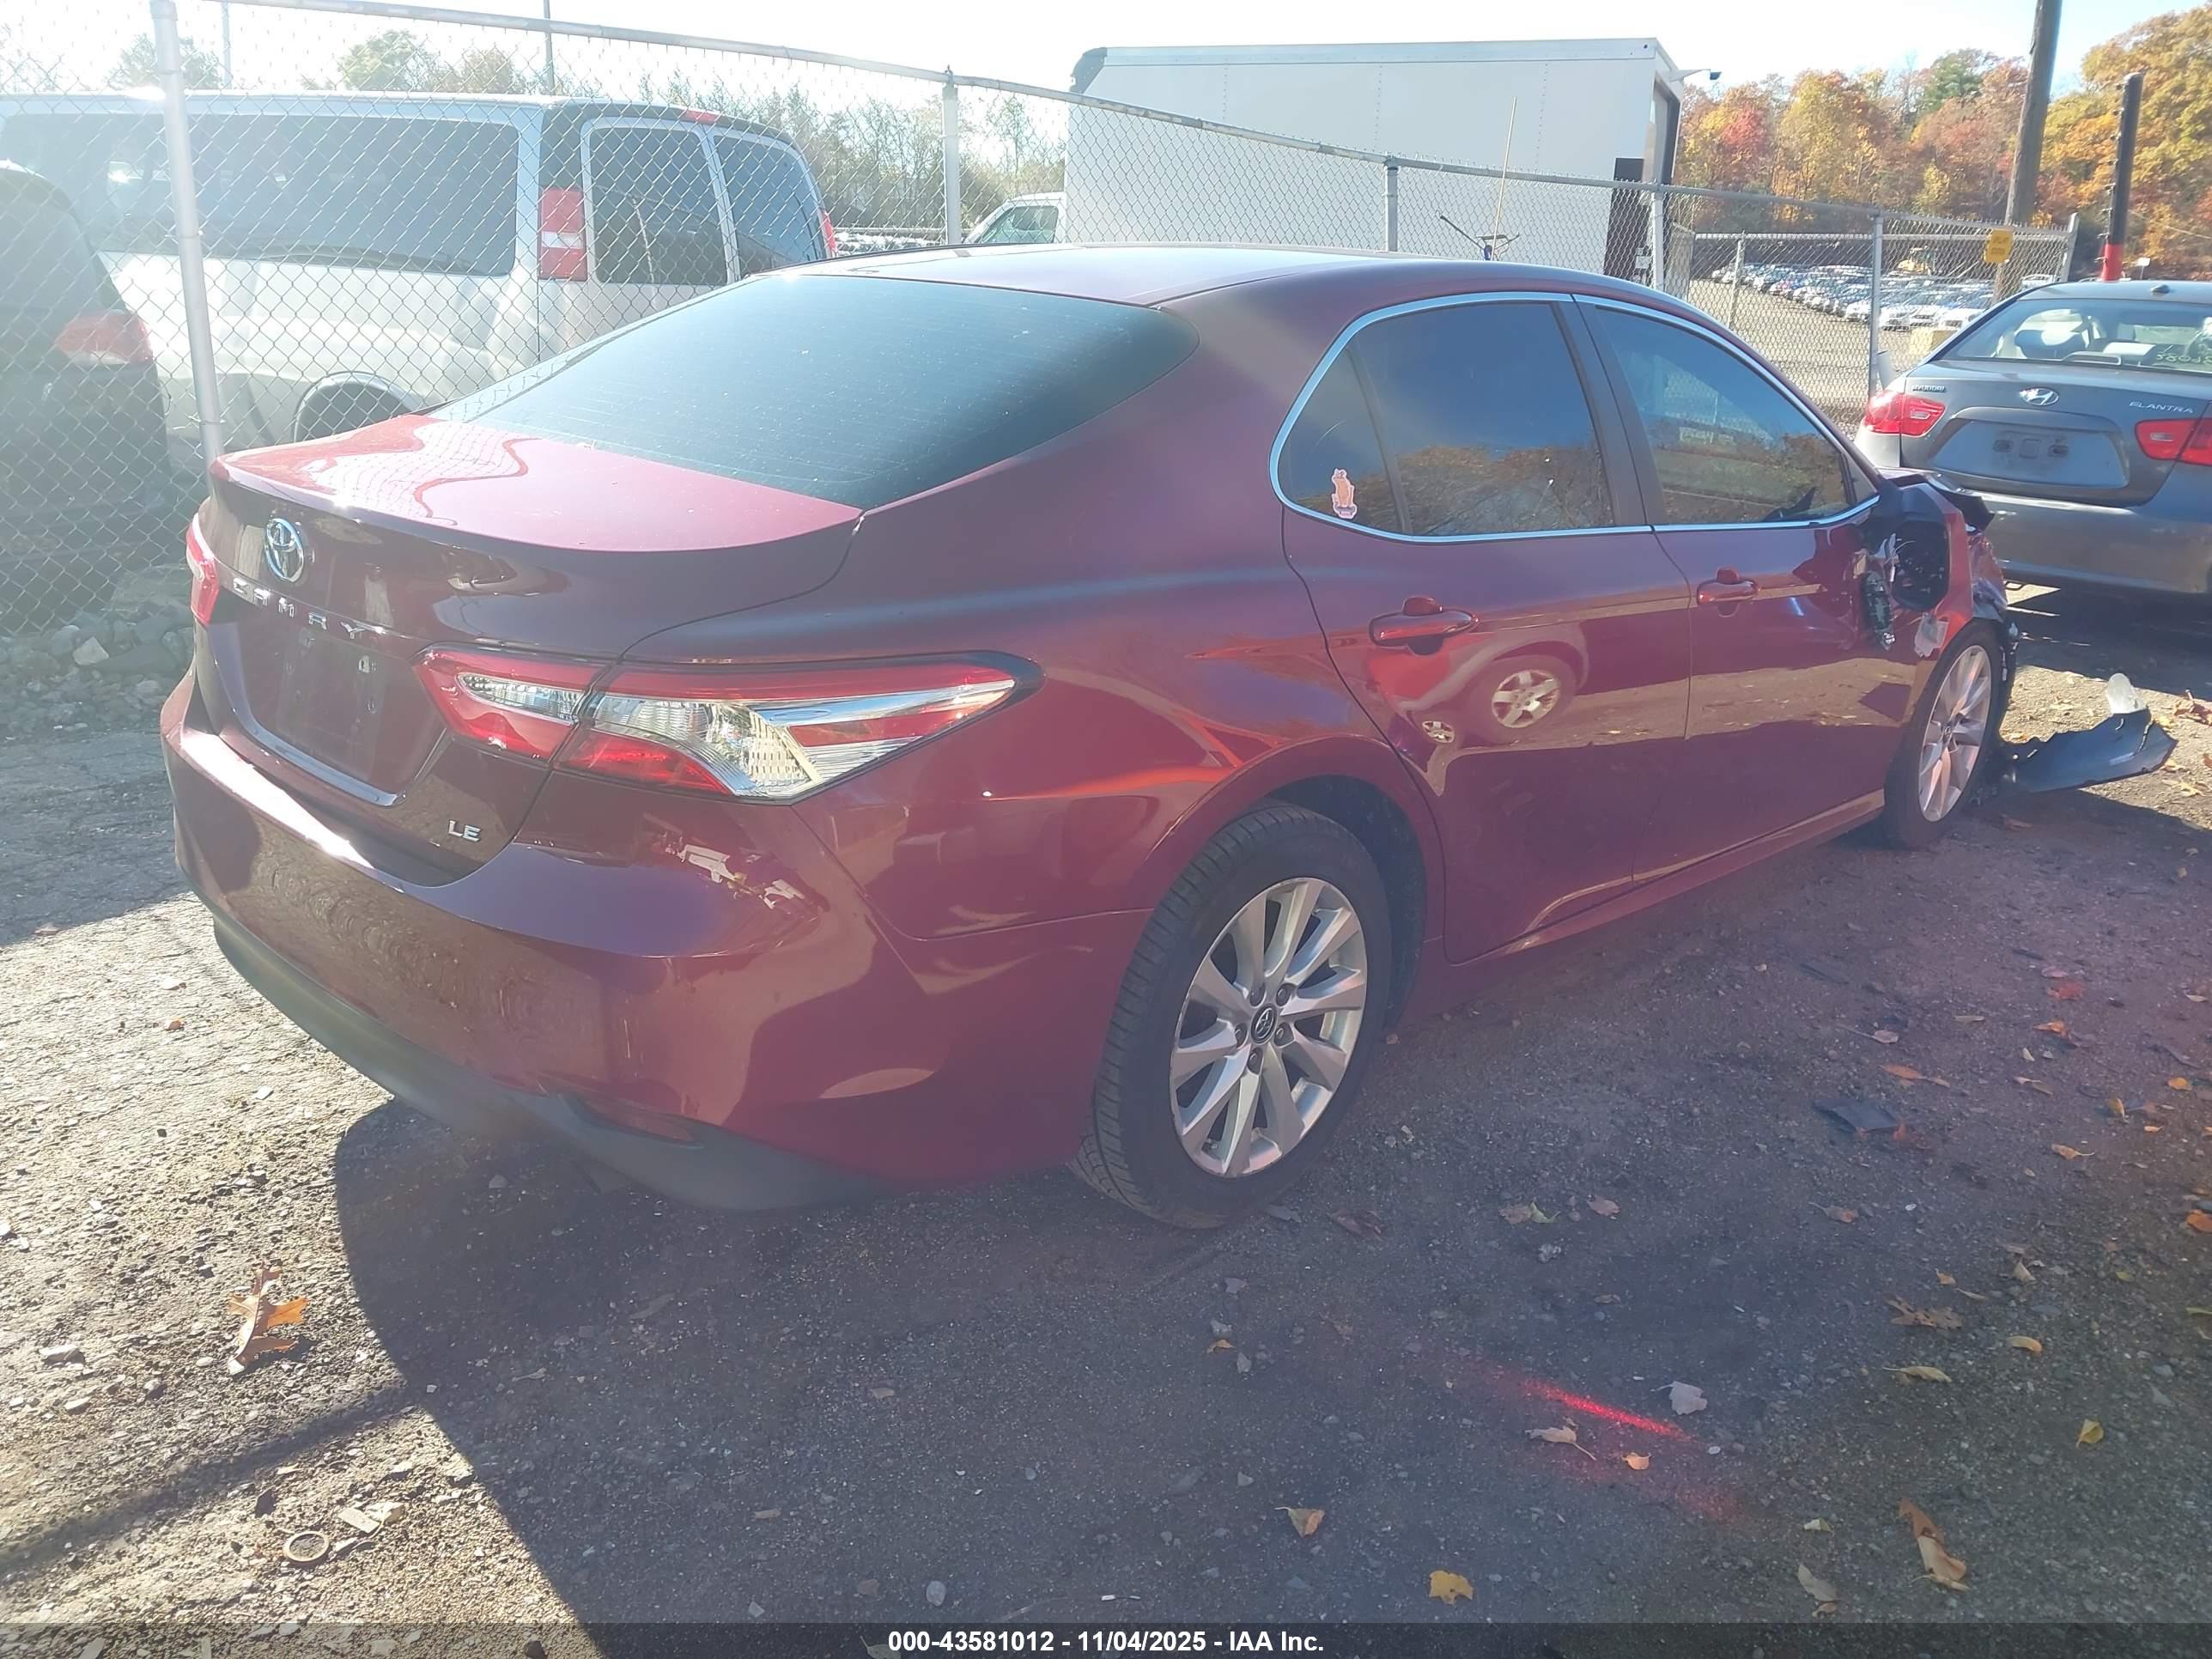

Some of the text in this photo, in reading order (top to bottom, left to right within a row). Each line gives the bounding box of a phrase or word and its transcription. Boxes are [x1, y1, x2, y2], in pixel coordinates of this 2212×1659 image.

[2129, 400, 2193, 414] ELANTRA
[233, 577, 366, 640] CAMRY
[448, 820, 481, 842] LE
